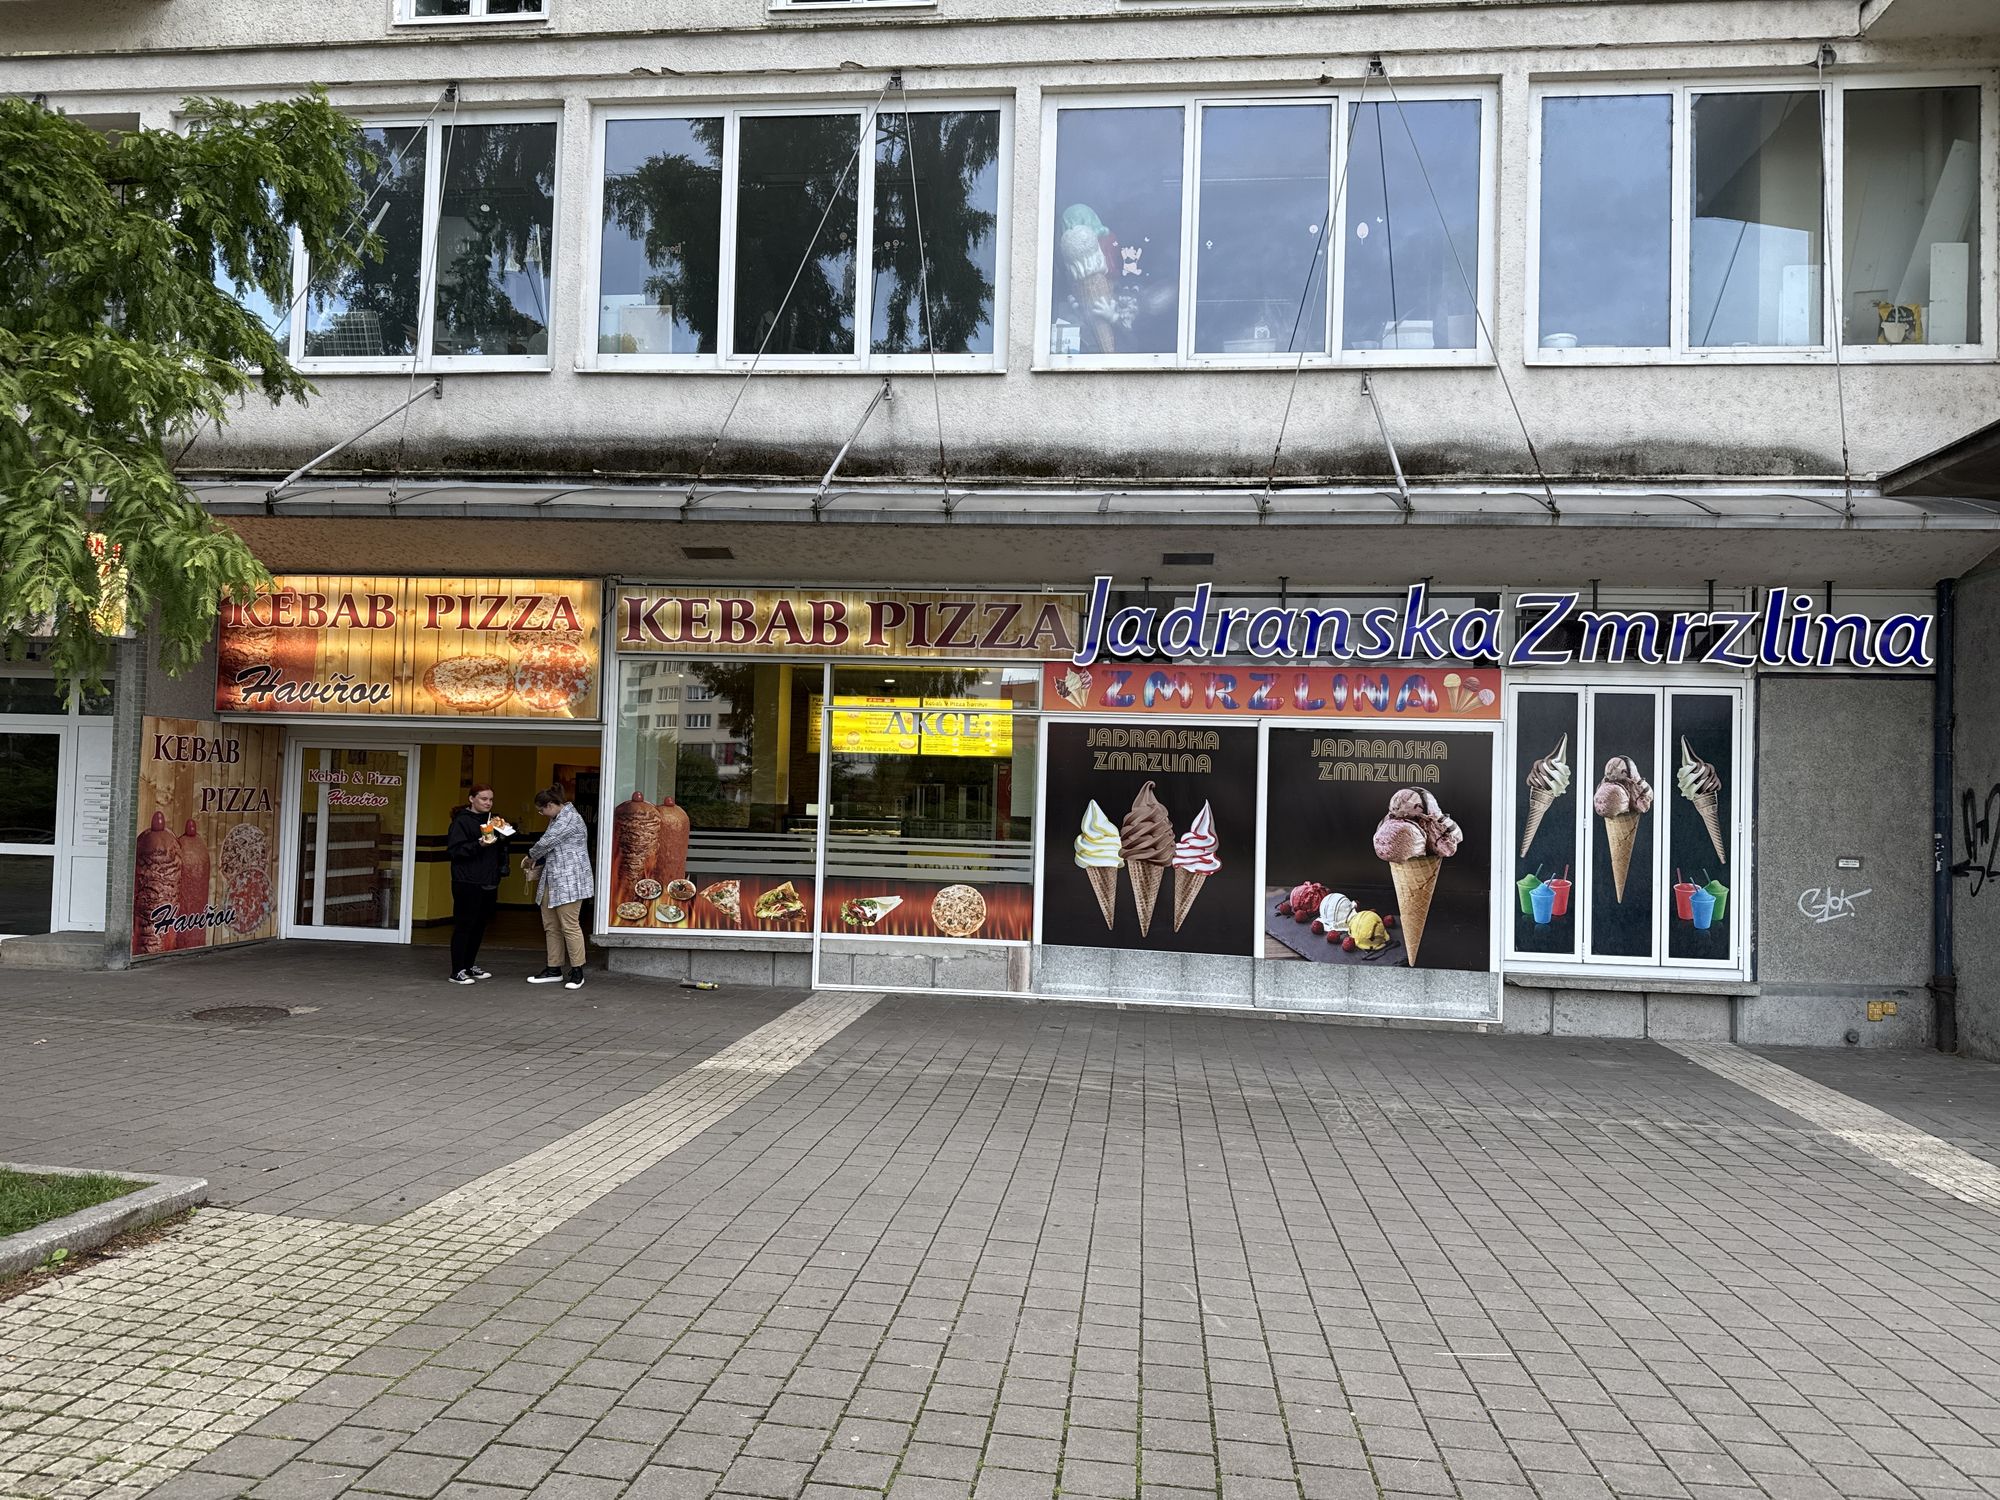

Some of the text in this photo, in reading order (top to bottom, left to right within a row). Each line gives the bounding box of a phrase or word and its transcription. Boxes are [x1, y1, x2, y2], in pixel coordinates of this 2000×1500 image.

[226, 592, 584, 632] KEBAB PIZZA
[622, 596, 1076, 651] KEBAB PIZZA
[1073, 576, 1934, 668] Jadranska Zmrzlina
[236, 664, 392, 705] Havířov
[1100, 669, 1440, 713] ZMRZLINA
[152, 734, 241, 765] KEBAB
[1086, 728, 1220, 750] JADRANSKA
[1311, 738, 1448, 760] JADRANSKA
[1093, 751, 1212, 773] ZMRZLINA
[1318, 761, 1440, 783] ZMRZLINA
[308, 769, 402, 786] Kebab & Pizza
[200, 786, 273, 813] PIZZA
[328, 789, 389, 806] Havířov
[150, 903, 237, 936] Havířov
